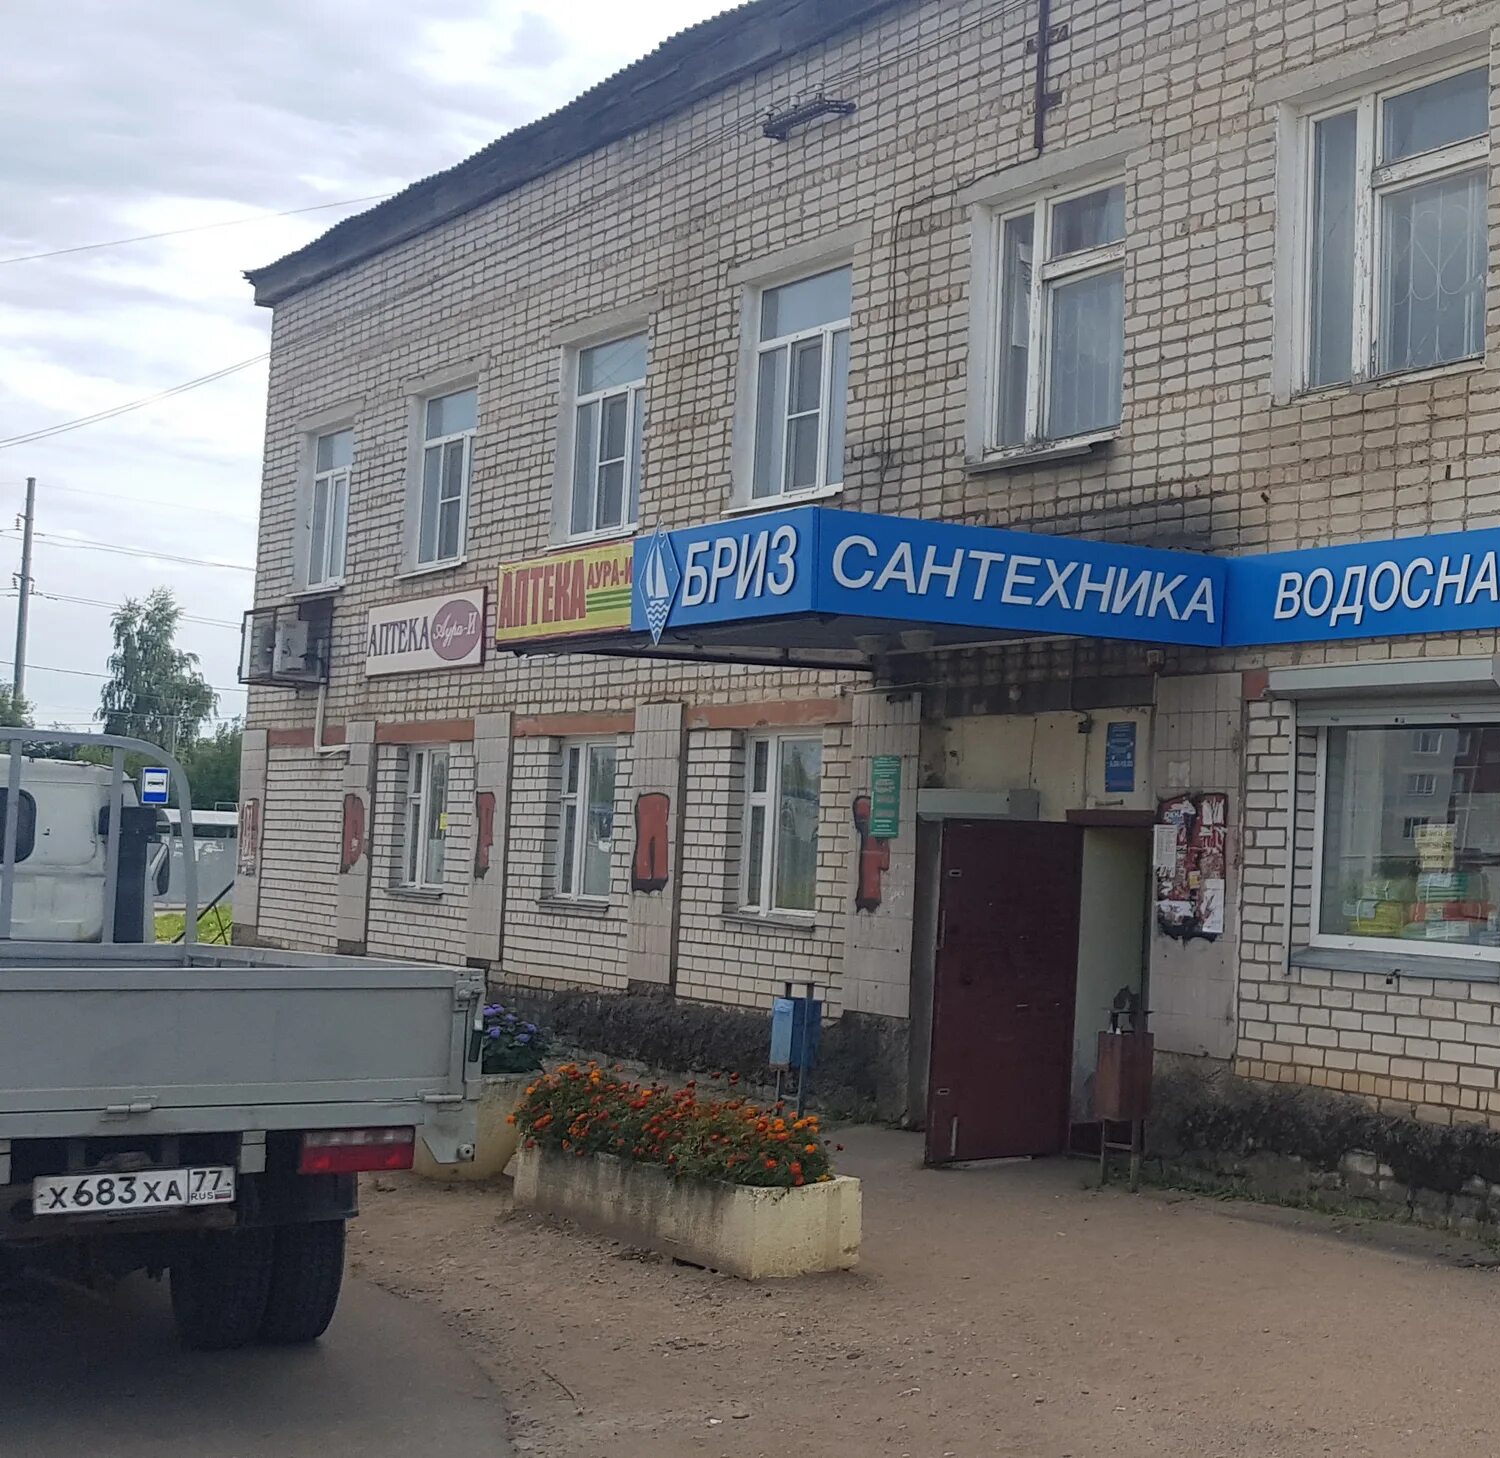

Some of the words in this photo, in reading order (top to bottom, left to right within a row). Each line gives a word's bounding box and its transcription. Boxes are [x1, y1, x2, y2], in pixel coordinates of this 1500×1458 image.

[498, 558, 586, 629] АПТЕКА
[681, 525, 797, 608] БРИЗ
[832, 534, 1216, 624] САНТЕХНИКА
[367, 615, 430, 658] АПТЕКА
[191, 1191, 214, 1201] RUS
[193, 1169, 223, 1192] 77
